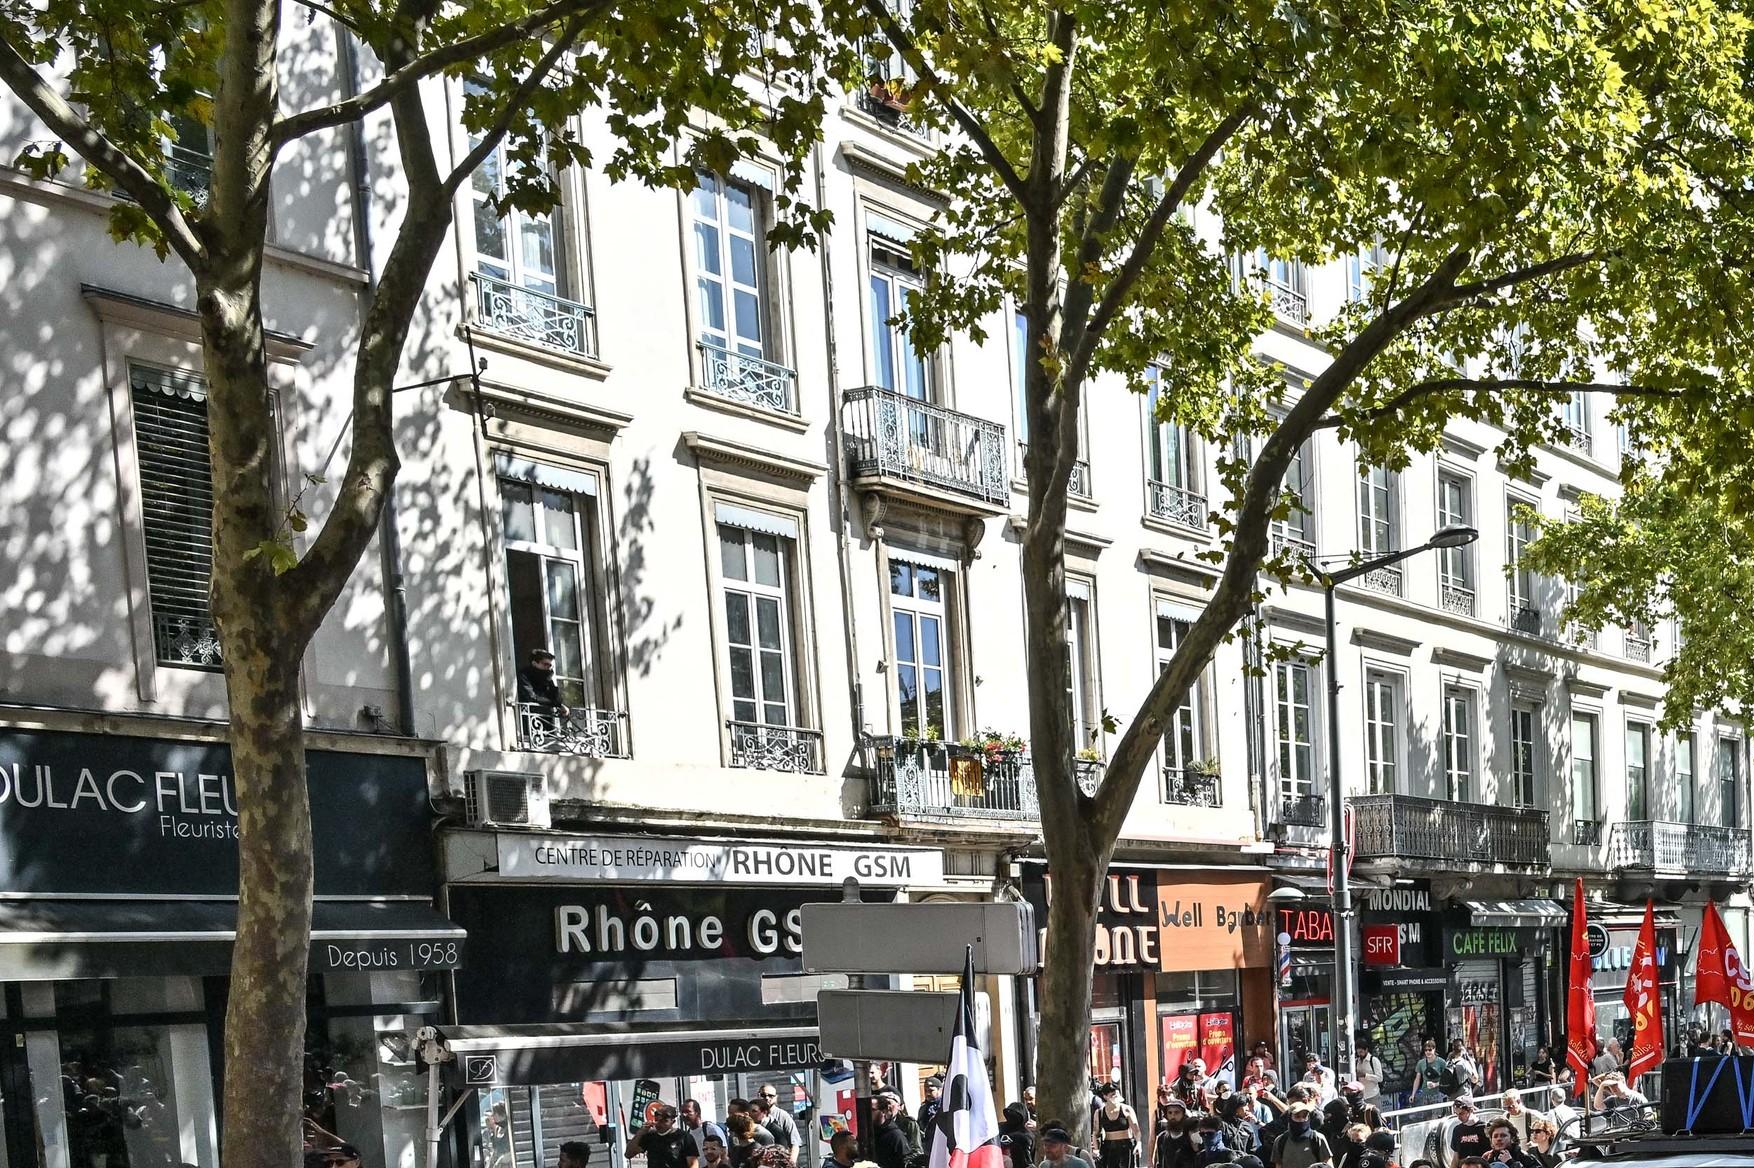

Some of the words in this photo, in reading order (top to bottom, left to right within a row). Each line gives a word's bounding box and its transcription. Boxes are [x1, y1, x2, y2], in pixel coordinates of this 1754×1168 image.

[535, 846, 598, 867] CENTRE
[602, 848, 623, 868] DE
[627, 845, 716, 869] RÉPARATION
[732, 846, 833, 877] RHÔNE
[853, 854, 912, 879] GSM
[1043, 874, 1149, 914] LL
[1368, 889, 1432, 912] MONDIAL
[554, 900, 724, 954] Rhône
[747, 908, 801, 954] GS
[1161, 900, 1203, 928] Well
[1216, 902, 1272, 934] Barber
[1279, 909, 1334, 942] TABA
[1367, 936, 1393, 954] SFR
[1400, 922, 1421, 945] SM
[1453, 926, 1486, 955] CAFÉ
[1489, 926, 1518, 954] FÉLIX
[328, 944, 398, 971] Depuis
[410, 942, 458, 965] 1958
[701, 1046, 761, 1069] DULAC
